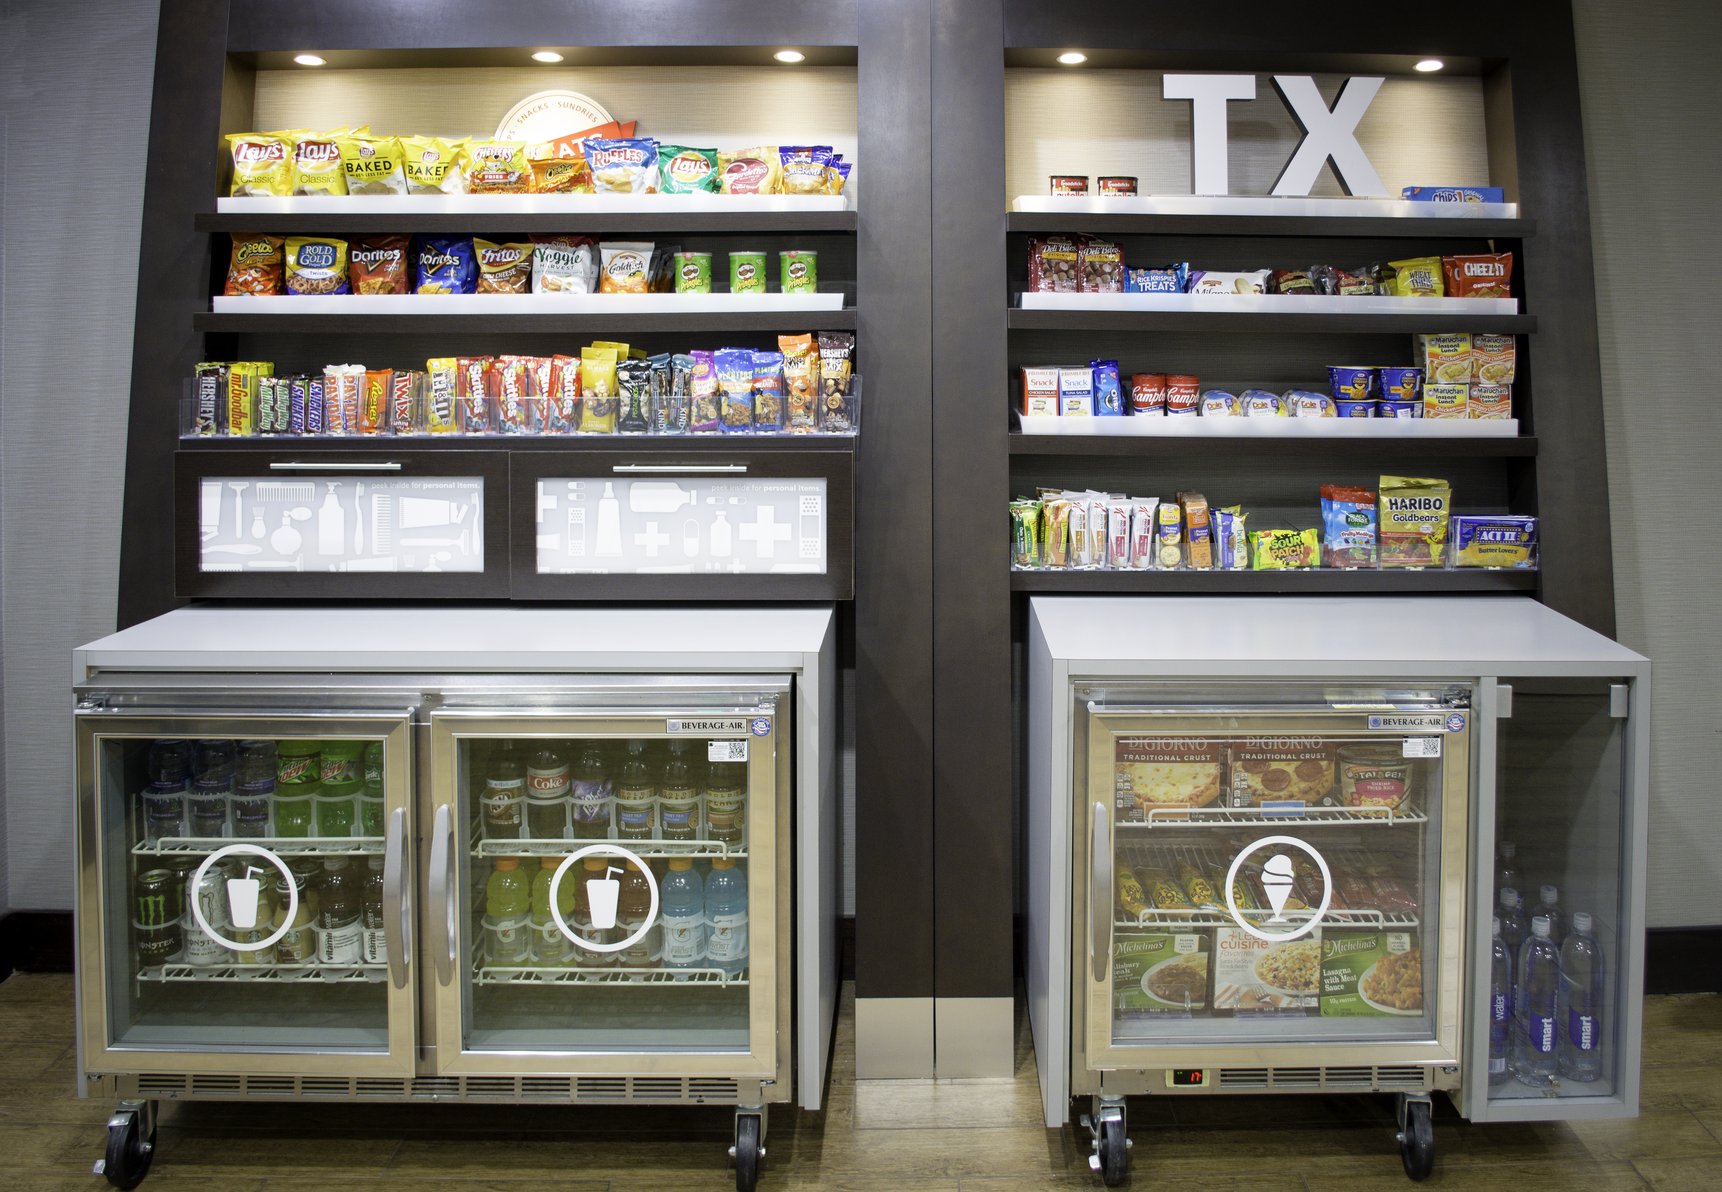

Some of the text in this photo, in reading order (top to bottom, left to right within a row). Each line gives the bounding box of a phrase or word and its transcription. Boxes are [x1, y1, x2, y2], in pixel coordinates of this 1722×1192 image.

[517, 101, 599, 124] SNACKS SUNDRIES
[1162, 74, 1390, 200] TX
[593, 150, 644, 168] RUFFLES
[346, 160, 392, 173] BAKED
[240, 174, 275, 184] Classic
[300, 174, 336, 184] Classic
[238, 242, 274, 264] Cheetos
[306, 245, 333, 256] ROLD
[352, 249, 401, 263] Doritos
[481, 248, 521, 264] Fritos
[535, 247, 584, 266] Veggie
[301, 254, 332, 266] GOLD
[420, 252, 460, 266] Doritos
[608, 260, 644, 274] Goldfish
[496, 270, 517, 280] CHEESE
[1410, 271, 1432, 280] WHEAT
[681, 278, 703, 291] Pringles
[736, 278, 759, 291] Pringles
[788, 276, 810, 290] Pringles
[1138, 281, 1176, 292] TREATS
[1031, 378, 1055, 386] Snack
[1065, 378, 1088, 387] Snack
[469, 364, 485, 414] Skittles
[503, 366, 519, 418] Skittles
[562, 364, 577, 415] Skittles
[1433, 387, 1464, 395] Maruchan
[310, 382, 322, 431] SNICKERS
[1111, 389, 1120, 413] OREO
[292, 385, 304, 432] SNICKERS
[679, 408, 688, 428] KIND
[411, 480, 421, 489] for
[422, 480, 456, 490] personal
[763, 484, 797, 493] personal
[1389, 498, 1443, 511] HARIBO
[1393, 513, 1440, 523] Goldbears
[1270, 535, 1302, 549] SOUR
[1480, 531, 1517, 541] ACT II
[1270, 545, 1304, 558] PATCH
[681, 721, 744, 730] BEVERAGE-AIR
[1382, 718, 1442, 726] BEVERAGE-AIR
[1123, 754, 1212, 762] TRADITIONAL CRUST
[1241, 752, 1327, 761] TRADITIONAL CRUST
[534, 777, 564, 790] Coke
[1114, 940, 1164, 957] Michelina's
[1220, 939, 1269, 950] cuisine
[1327, 939, 1376, 957] Michelina's
[1322, 968, 1352, 977] Lasagna
[1323, 974, 1357, 984] with Meat
[1324, 984, 1345, 992] Sauce
[1494, 993, 1505, 1021] water
[1542, 1016, 1553, 1053] smart
[1580, 1015, 1592, 1050] smart
